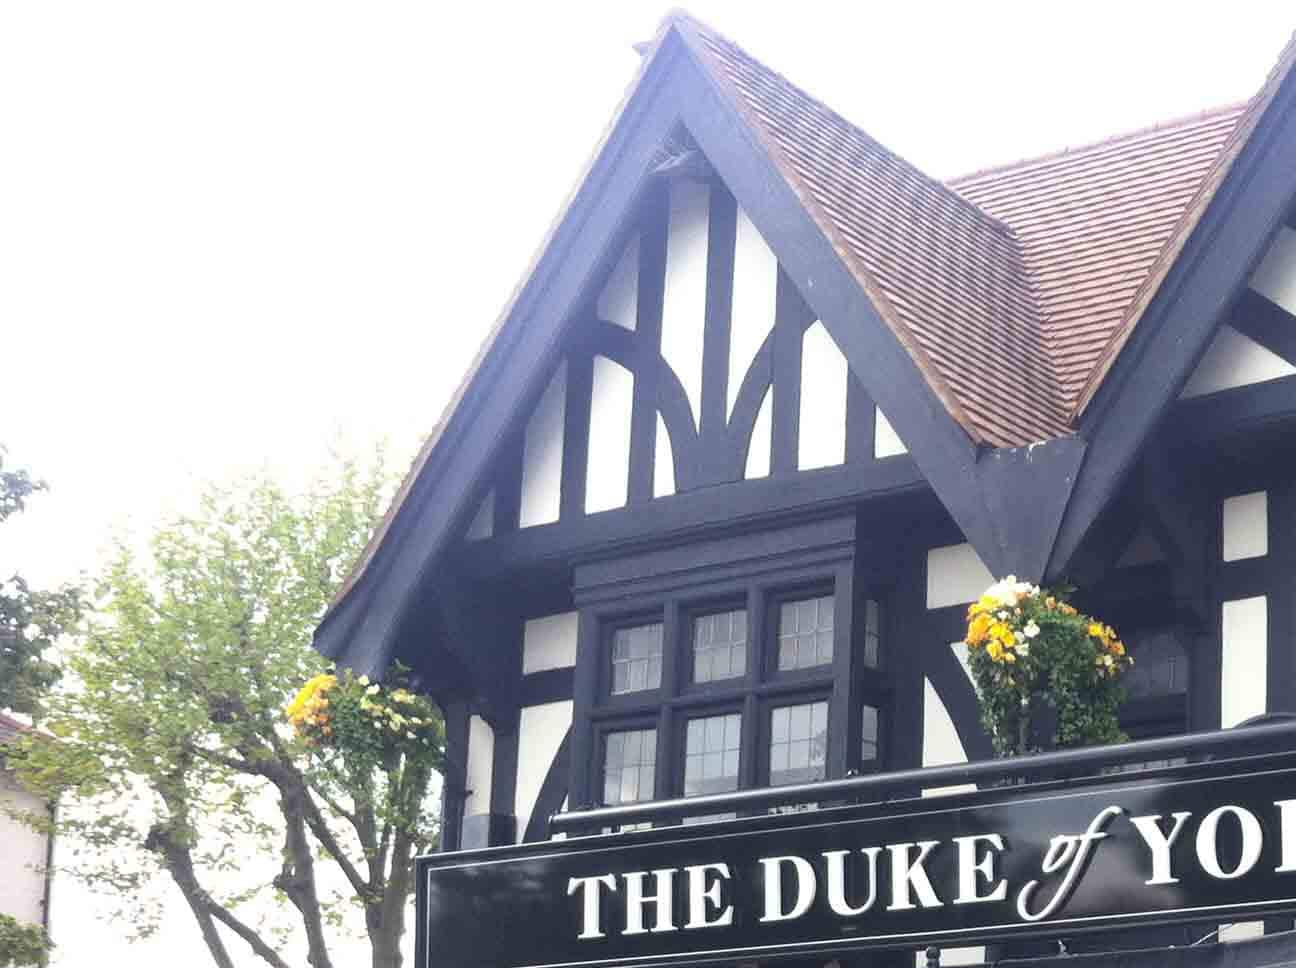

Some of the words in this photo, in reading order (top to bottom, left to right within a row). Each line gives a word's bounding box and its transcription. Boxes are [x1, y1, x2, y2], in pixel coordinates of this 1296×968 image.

[567, 863, 734, 939] THE
[758, 833, 1009, 922] DUKE
[1016, 805, 1121, 921] of
